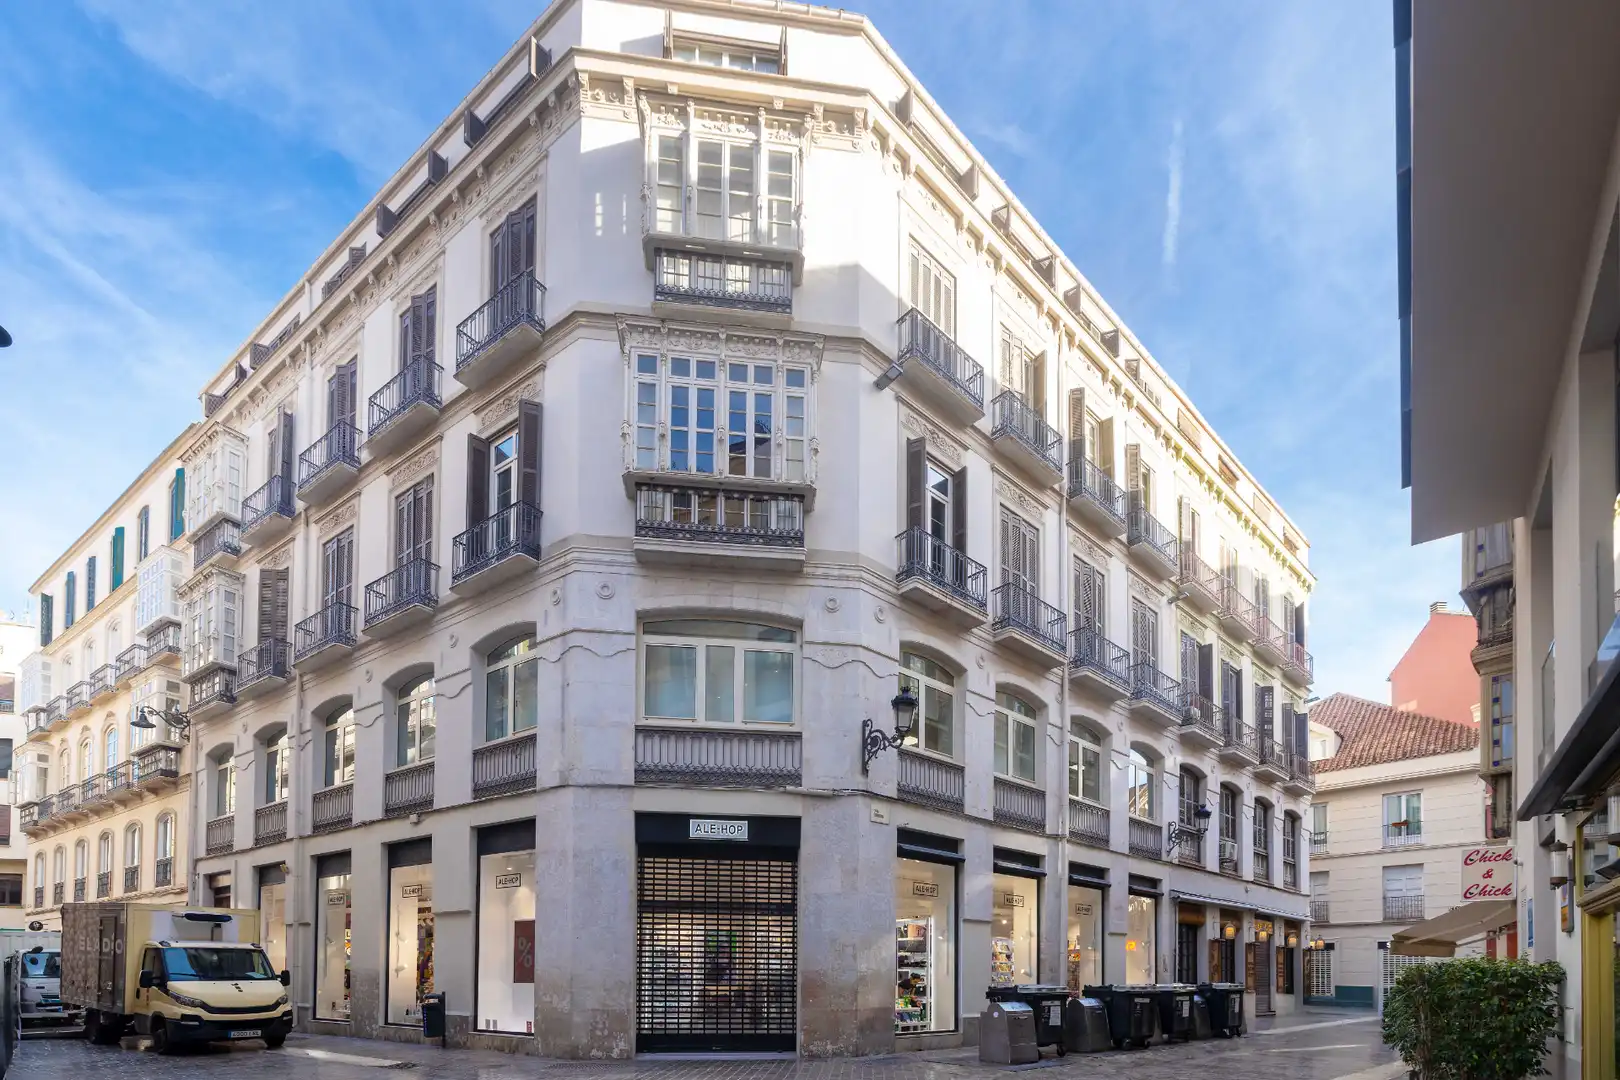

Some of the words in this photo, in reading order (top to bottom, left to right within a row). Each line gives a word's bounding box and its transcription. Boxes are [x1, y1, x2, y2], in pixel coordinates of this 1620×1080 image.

[695, 823, 744, 835] ALE-HOP
[1464, 848, 1513, 866] Chick
[1482, 868, 1493, 879] &
[1464, 883, 1512, 899] Chick
